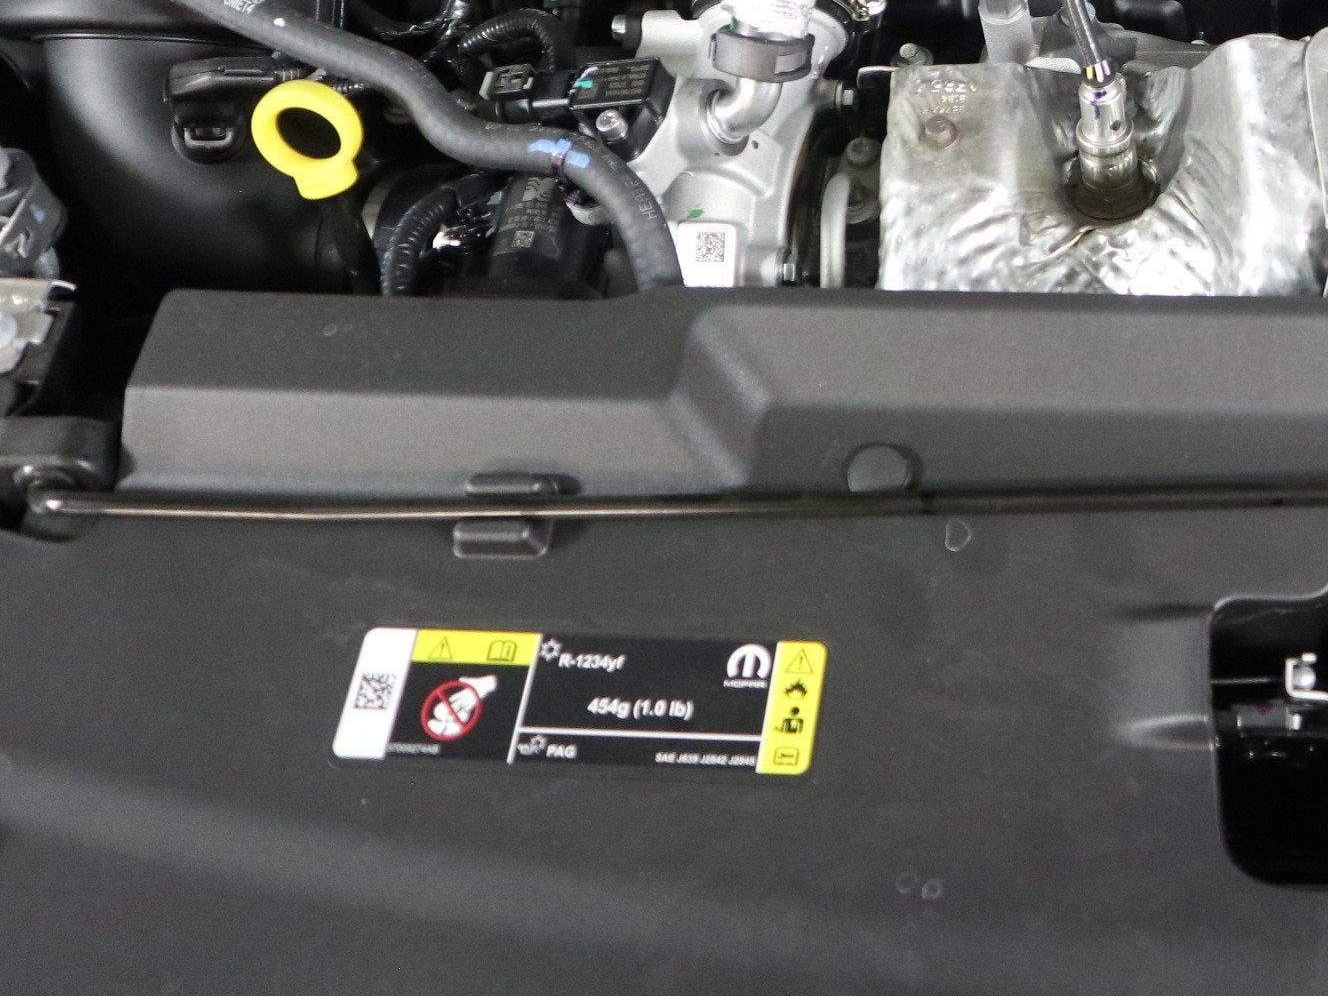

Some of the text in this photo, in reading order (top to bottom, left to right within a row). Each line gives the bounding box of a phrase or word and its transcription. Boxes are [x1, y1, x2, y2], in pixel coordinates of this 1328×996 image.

[558, 652, 627, 673] R-1234yf
[722, 679, 768, 689] MOPAR
[586, 697, 695, 721] 454g (1.0 lb)
[546, 744, 578, 759] PAG
[654, 751, 677, 763] SAE
